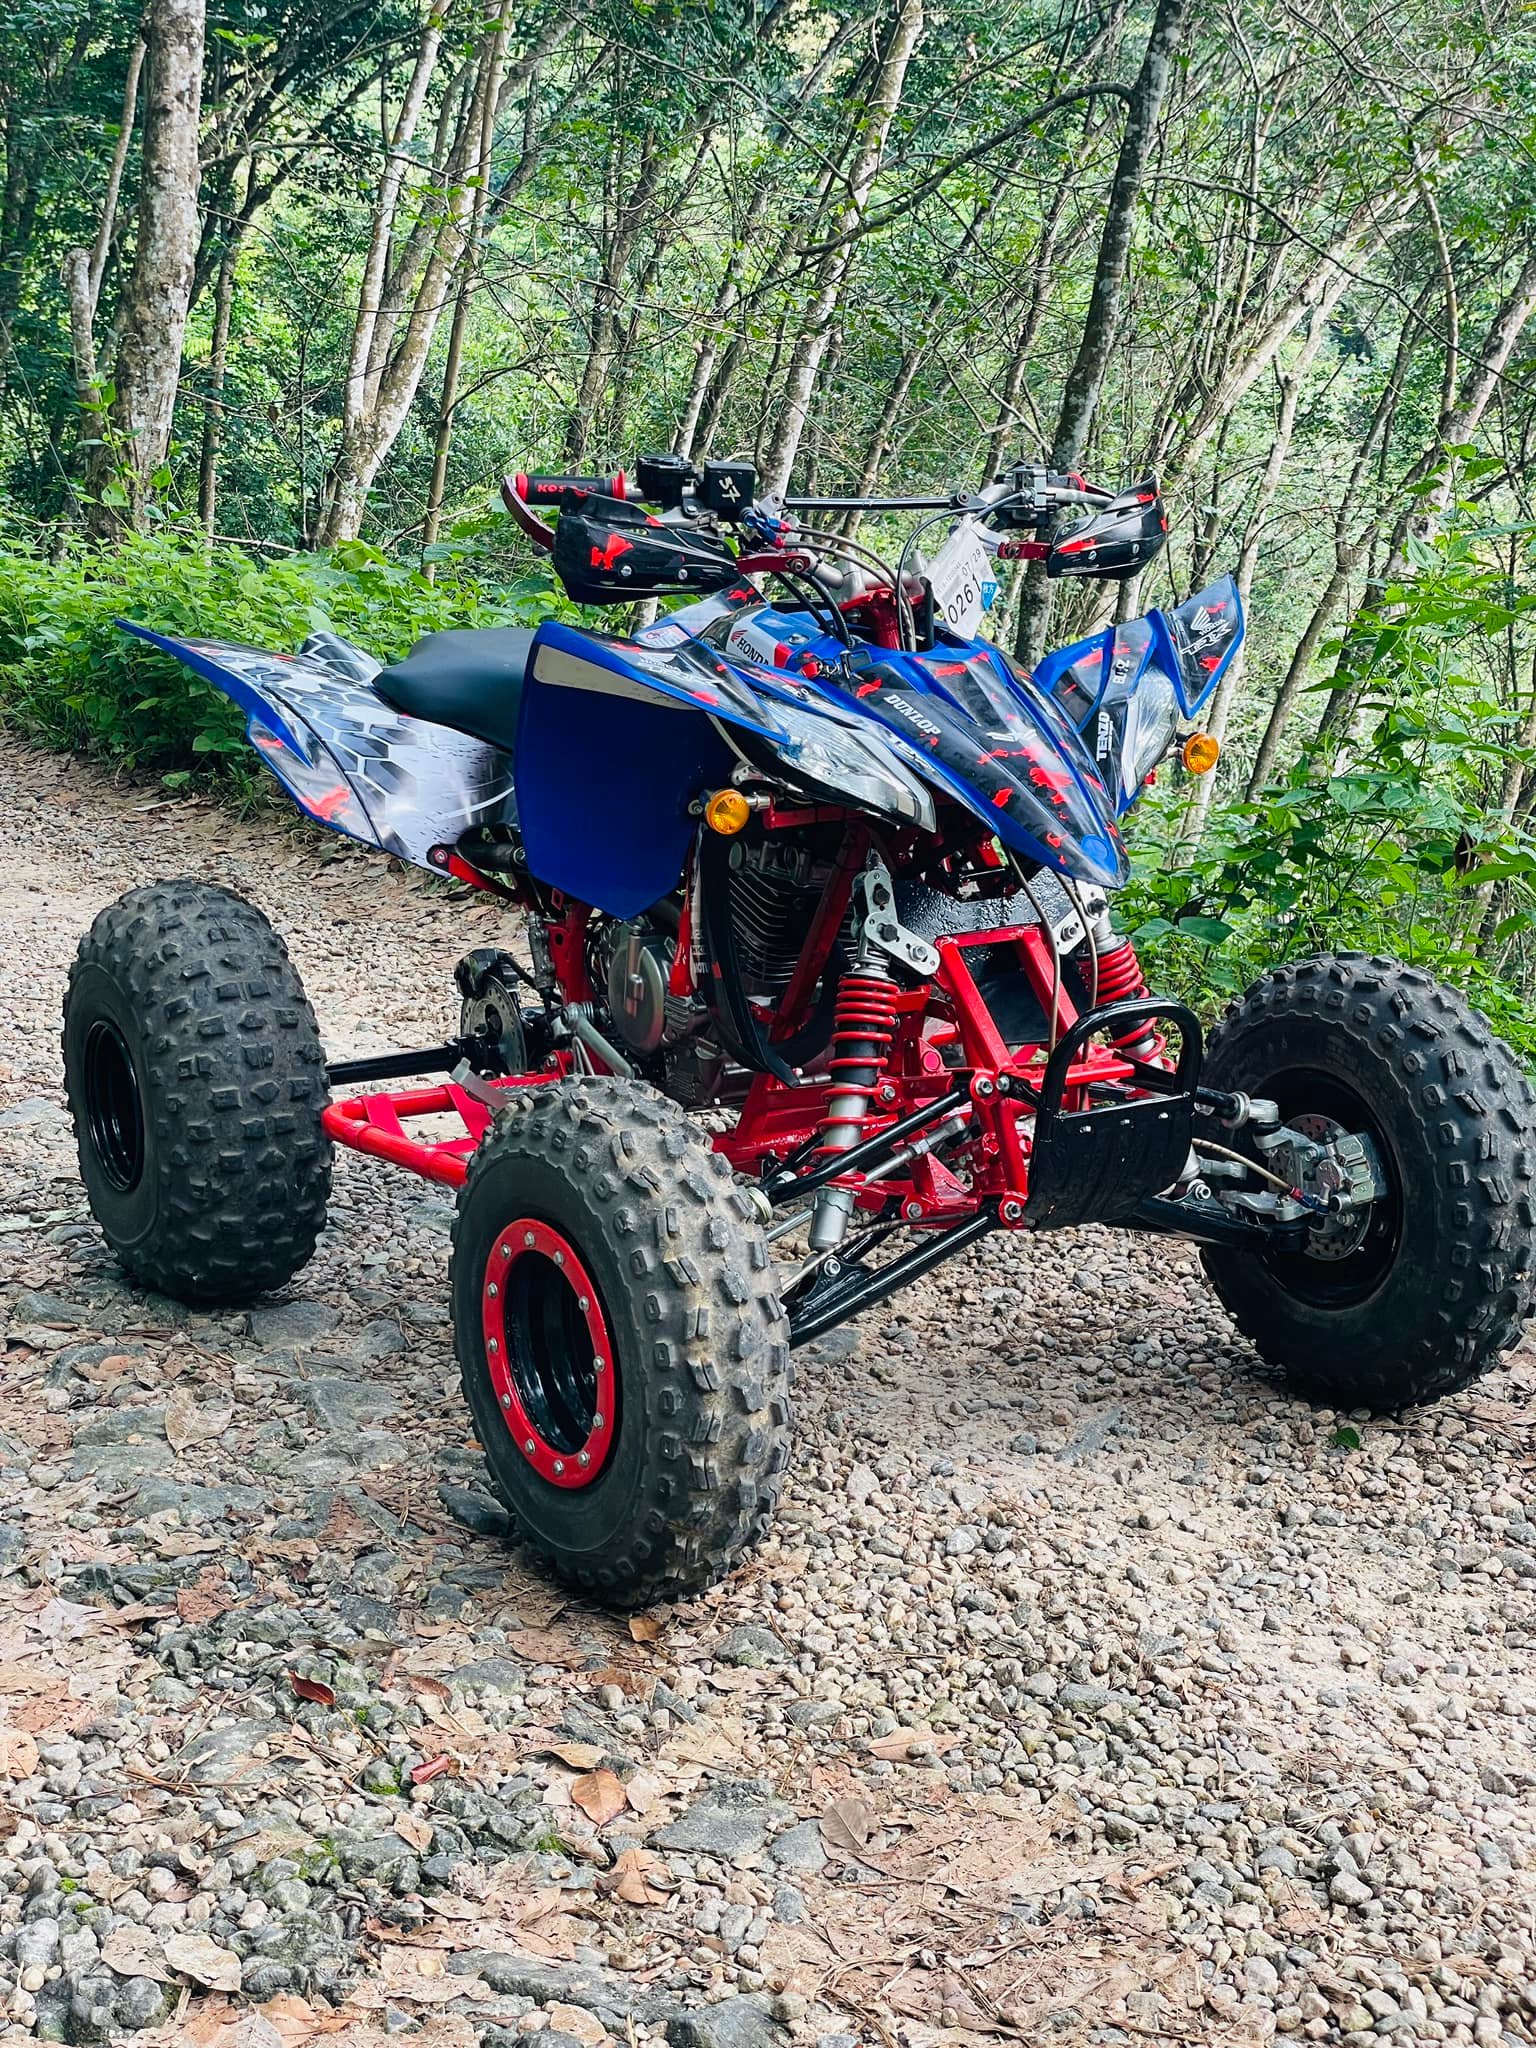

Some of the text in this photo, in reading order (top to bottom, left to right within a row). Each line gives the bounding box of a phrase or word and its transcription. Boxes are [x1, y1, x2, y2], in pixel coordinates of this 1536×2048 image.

[948, 573, 981, 624] 0261
[883, 694, 941, 735] DUNLOP
[1096, 711, 1110, 762] TENZO
